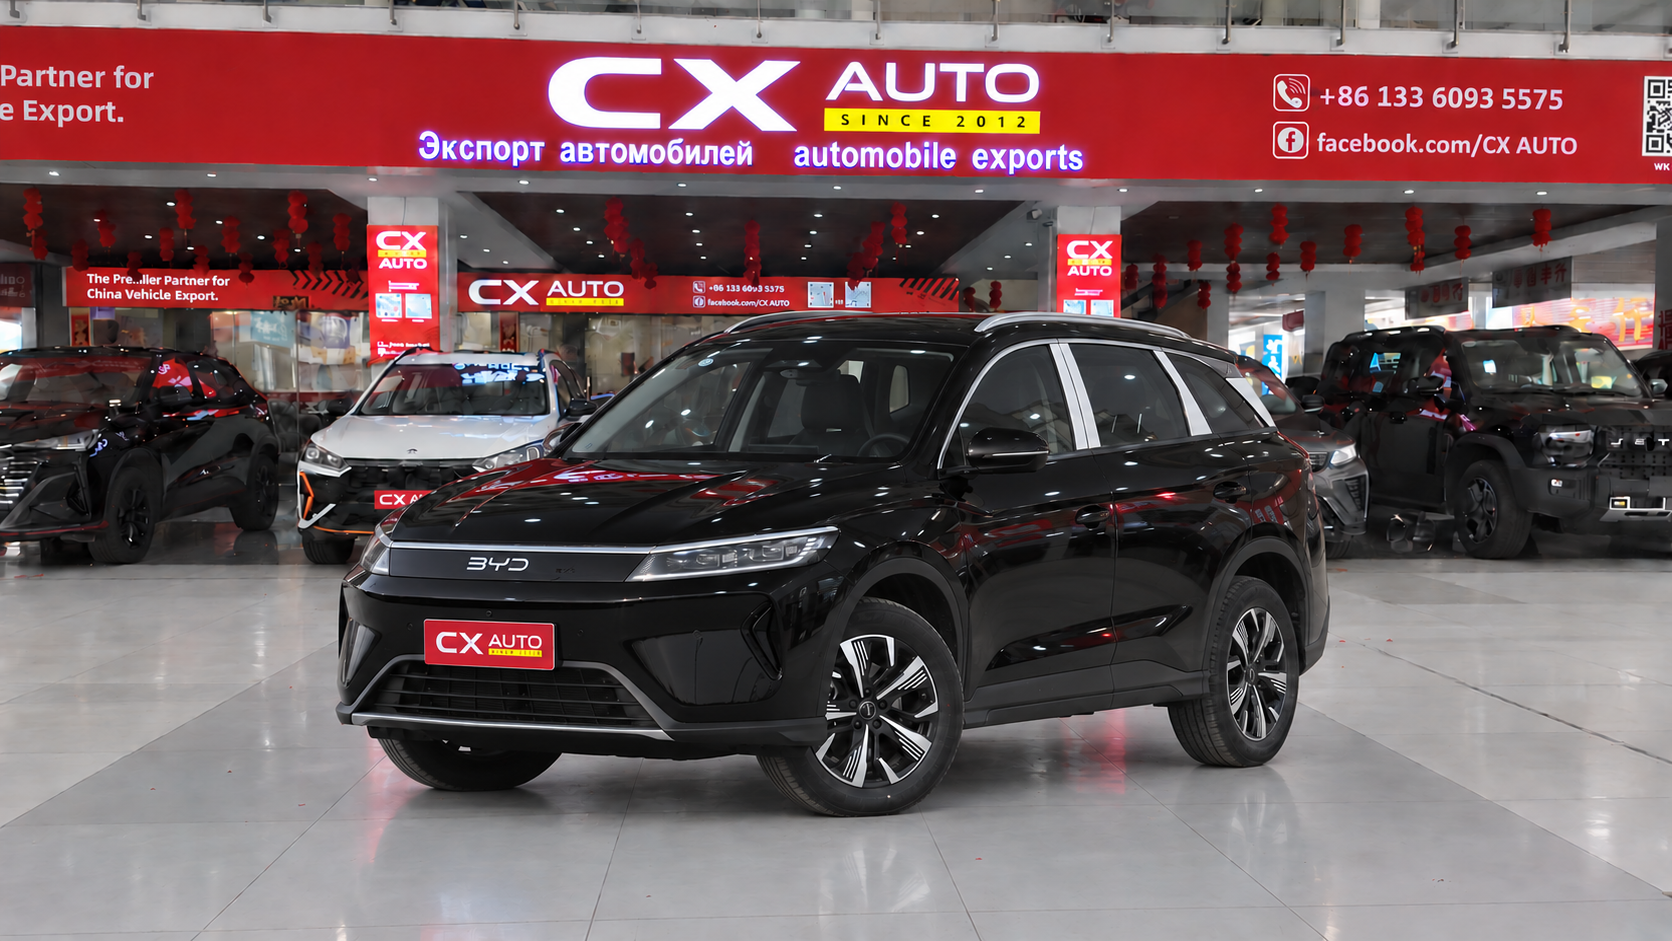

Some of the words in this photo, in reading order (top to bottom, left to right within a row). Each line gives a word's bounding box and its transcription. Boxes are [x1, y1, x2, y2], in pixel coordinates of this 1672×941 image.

[0, 64, 106, 89] Partner
[113, 66, 154, 90] for
[549, 57, 800, 132] CX
[826, 62, 1040, 103] AUTO
[1319, 86, 1369, 108] +86
[1378, 87, 1424, 109] 133
[1432, 87, 1494, 110] 6093
[1502, 89, 1563, 110] 5575
[23, 100, 124, 128] Export.
[841, 114, 931, 127] SINCE
[956, 115, 1026, 128] 2012
[418, 131, 546, 167] Экспорт
[559, 137, 754, 169] автомобилей
[1316, 132, 1511, 158] facebook.com/CX
[1515, 136, 1578, 156] AUTO
[793, 141, 957, 171] automobile
[972, 145, 1085, 174] exports
[376, 231, 427, 250] CX
[1066, 240, 1113, 260] CX
[378, 258, 428, 270] AUTO
[1067, 265, 1113, 277] AUTO
[86, 273, 110, 285] The
[164, 275, 211, 287] Partner
[211, 275, 231, 287] for
[86, 288, 123, 300] China
[124, 288, 172, 301] Vehicle
[175, 290, 219, 303] Export.
[469, 279, 540, 306] CX
[547, 280, 625, 298] AUTO
[769, 299, 791, 307] AUTO
[379, 494, 406, 506] CX
[466, 556, 529, 572] BYD
[436, 631, 484, 655] CX
[488, 634, 543, 650] AUTO
